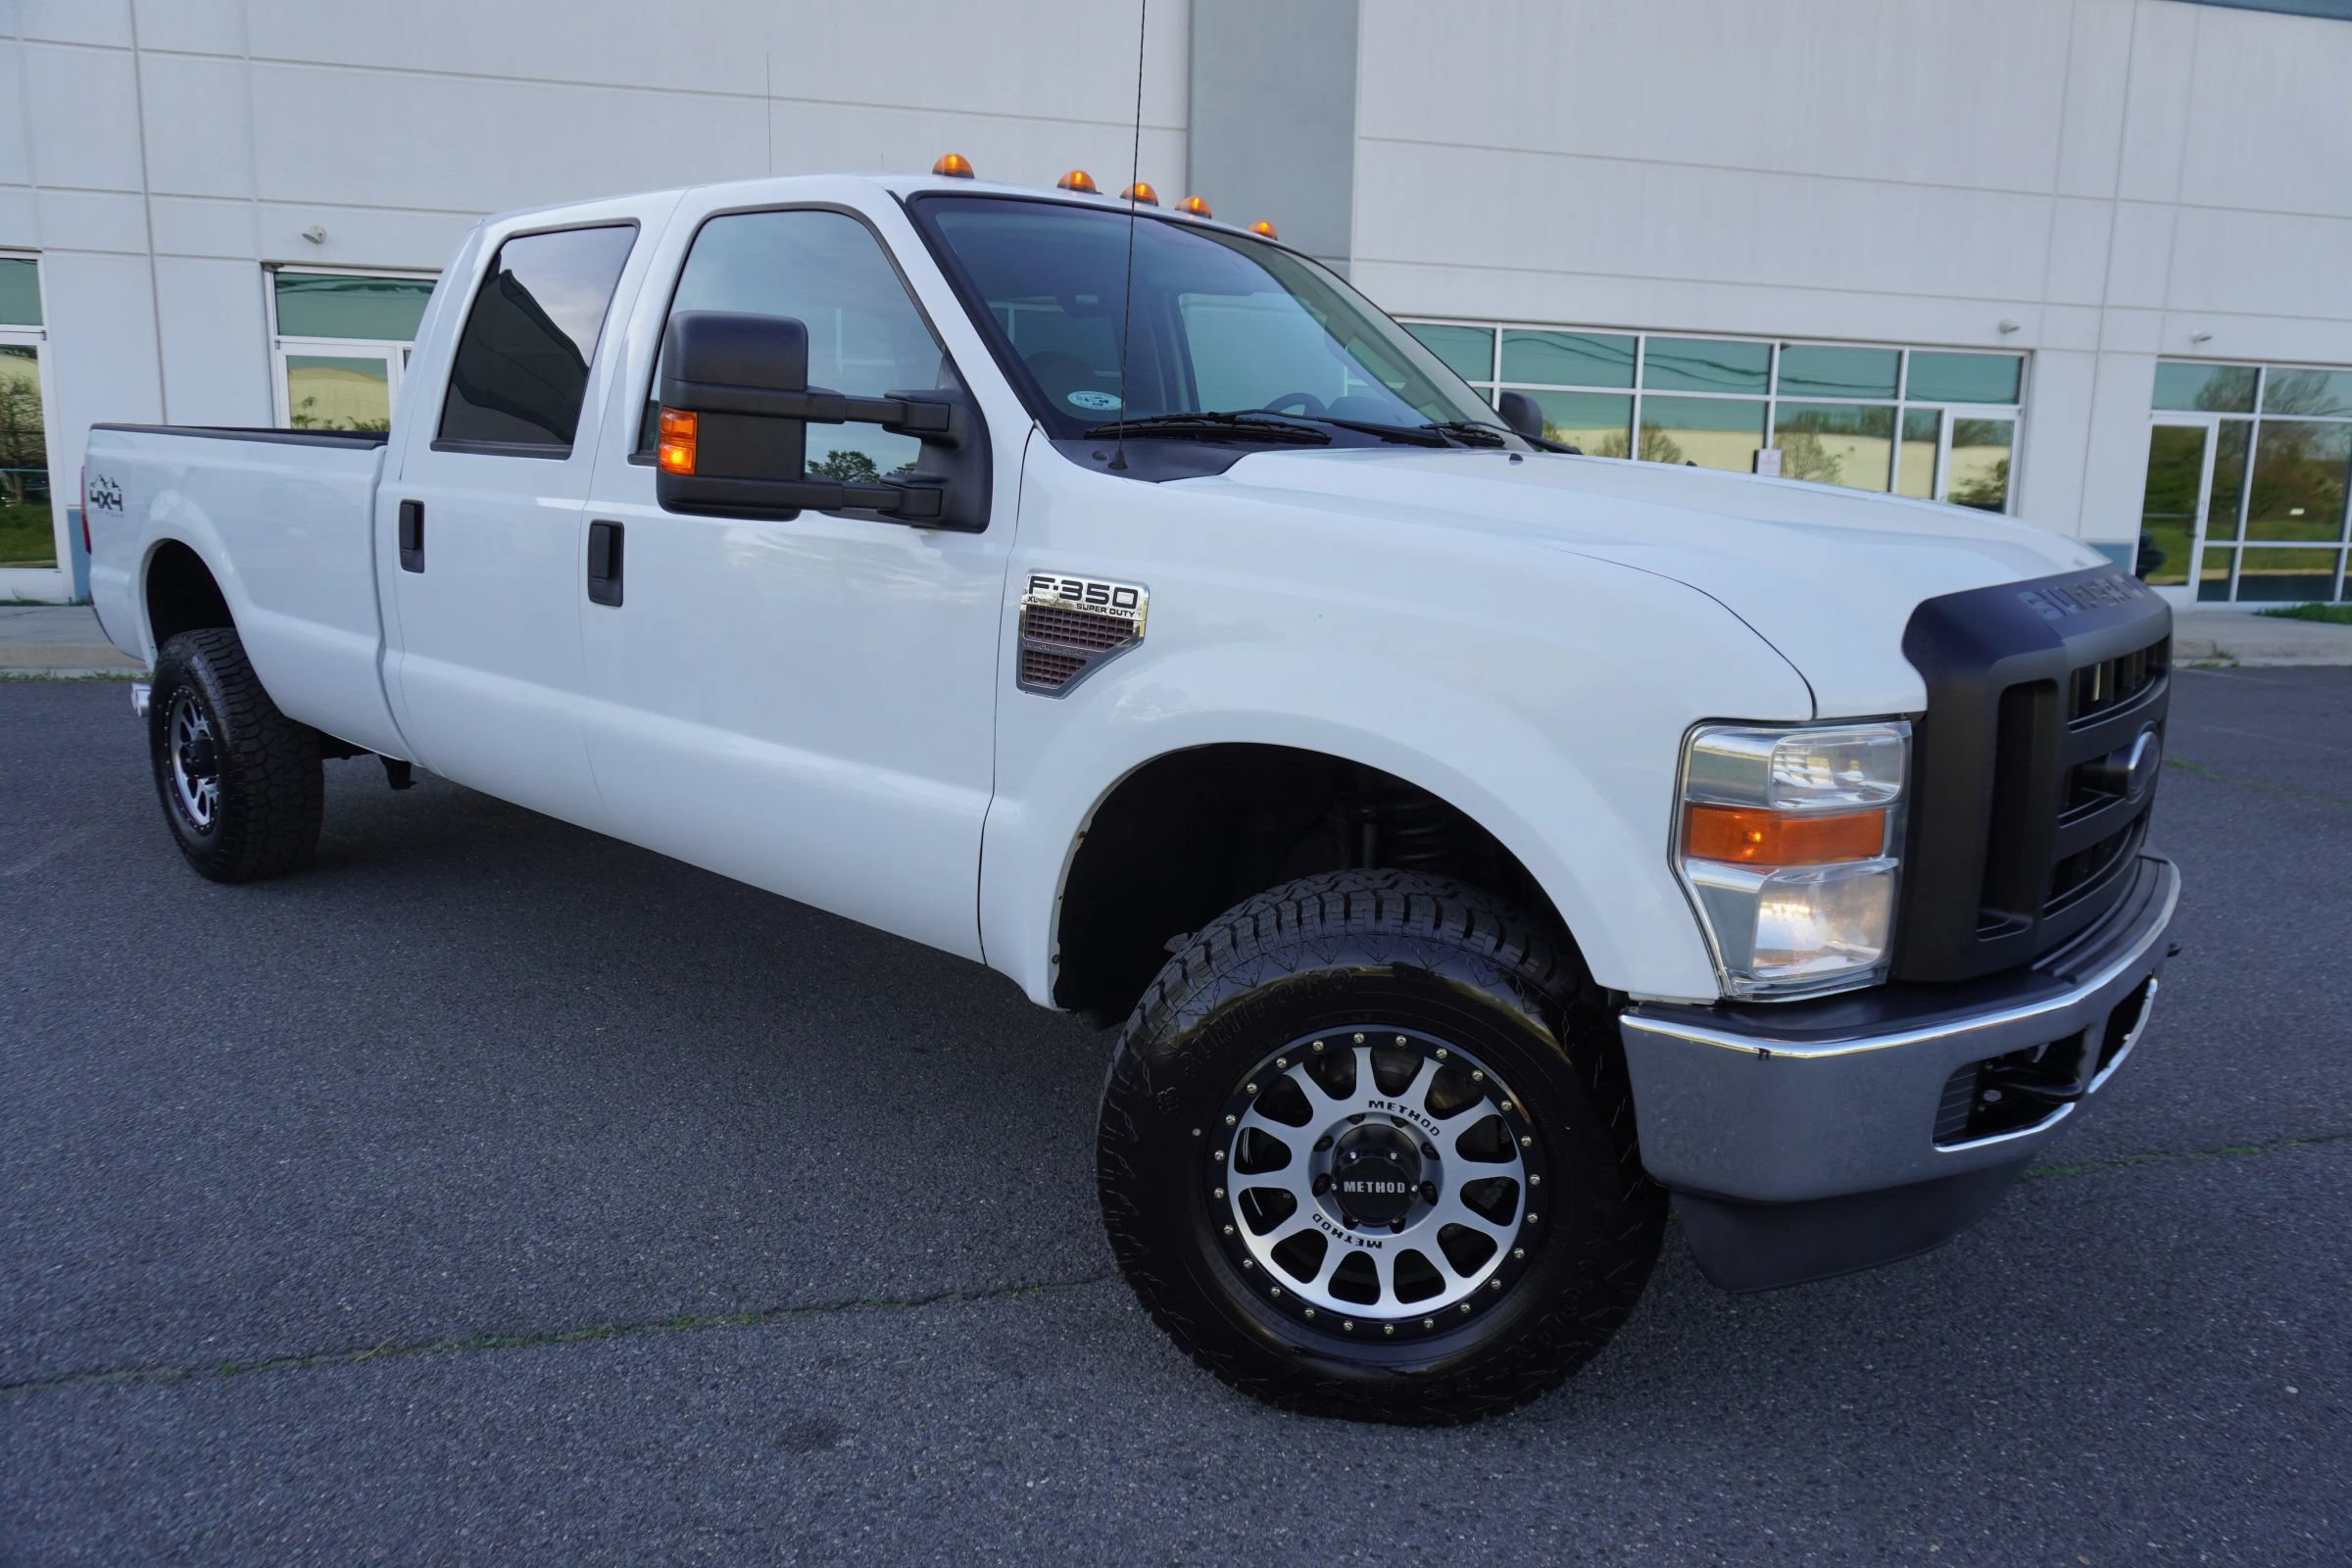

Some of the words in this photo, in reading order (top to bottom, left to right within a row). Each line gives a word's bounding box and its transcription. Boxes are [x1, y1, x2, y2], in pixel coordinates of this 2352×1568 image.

[1027, 595, 1038, 604] XL
[1076, 603, 1106, 613] SUPER
[1108, 608, 1135, 617] DUTY
[1368, 1100, 1441, 1137] METHOD
[1344, 1181, 1405, 1194] METHOD
[1312, 1213, 1383, 1250] METHOD
